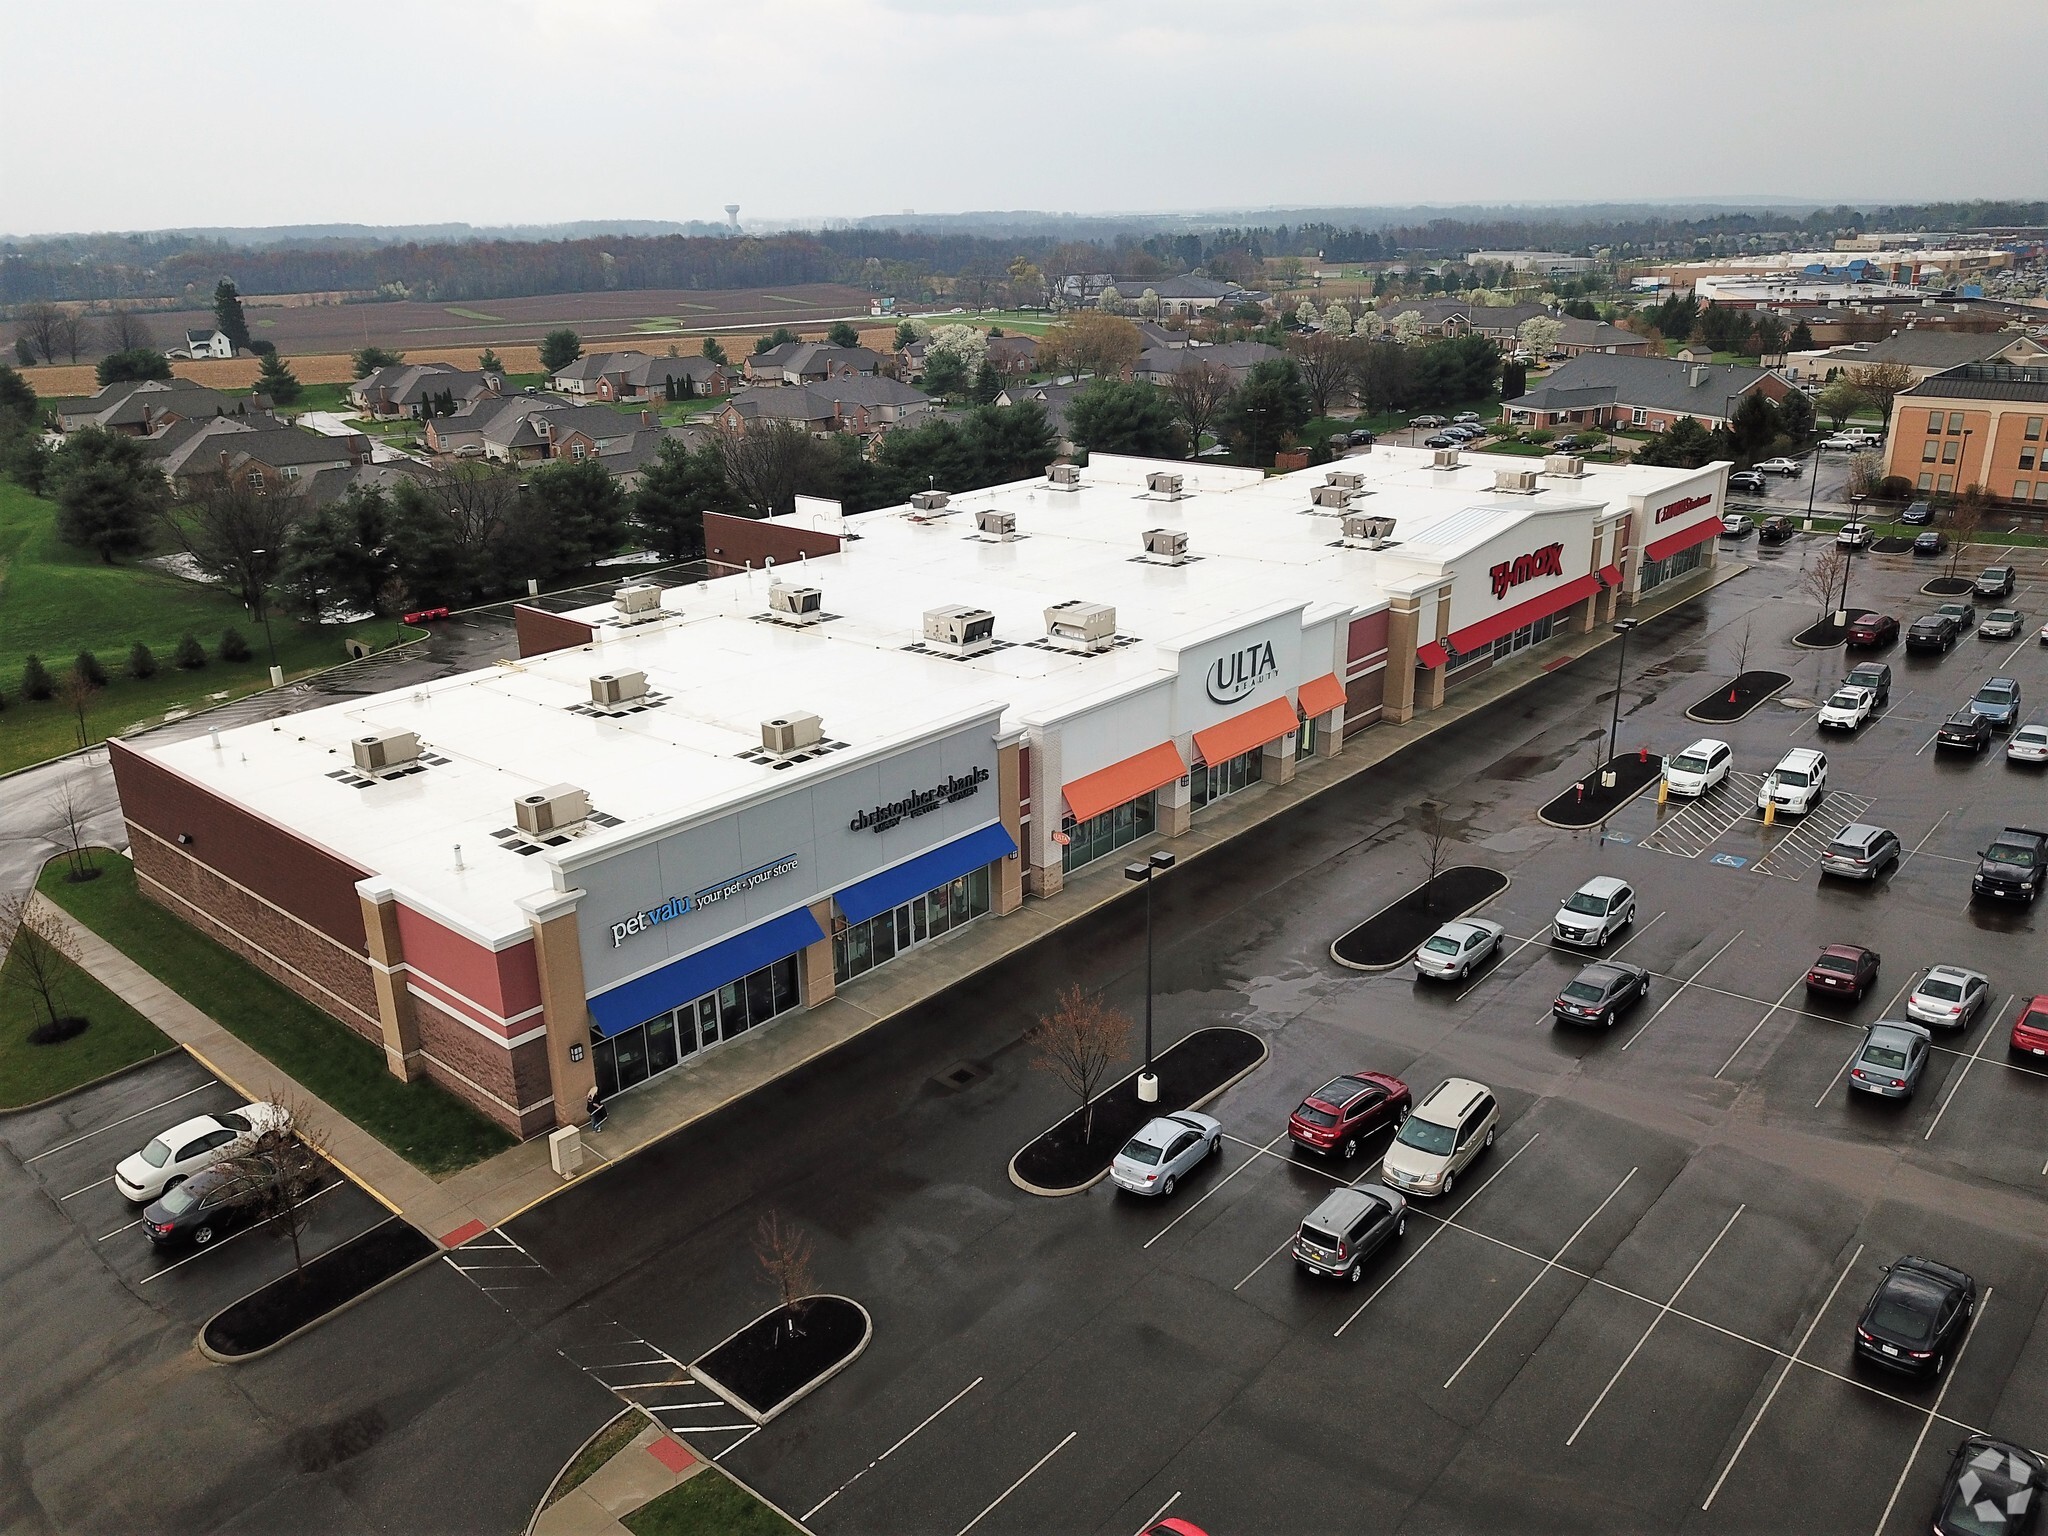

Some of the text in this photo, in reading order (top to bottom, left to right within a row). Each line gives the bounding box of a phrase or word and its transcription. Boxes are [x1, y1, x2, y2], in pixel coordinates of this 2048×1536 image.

[1217, 640, 1276, 690] ULTA
[1233, 669, 1280, 693] BEAUTY
[947, 785, 978, 804] WOMEN
[695, 889, 722, 911] your
[723, 881, 741, 900] pet
[747, 870, 772, 890] your
[773, 859, 799, 877] store
